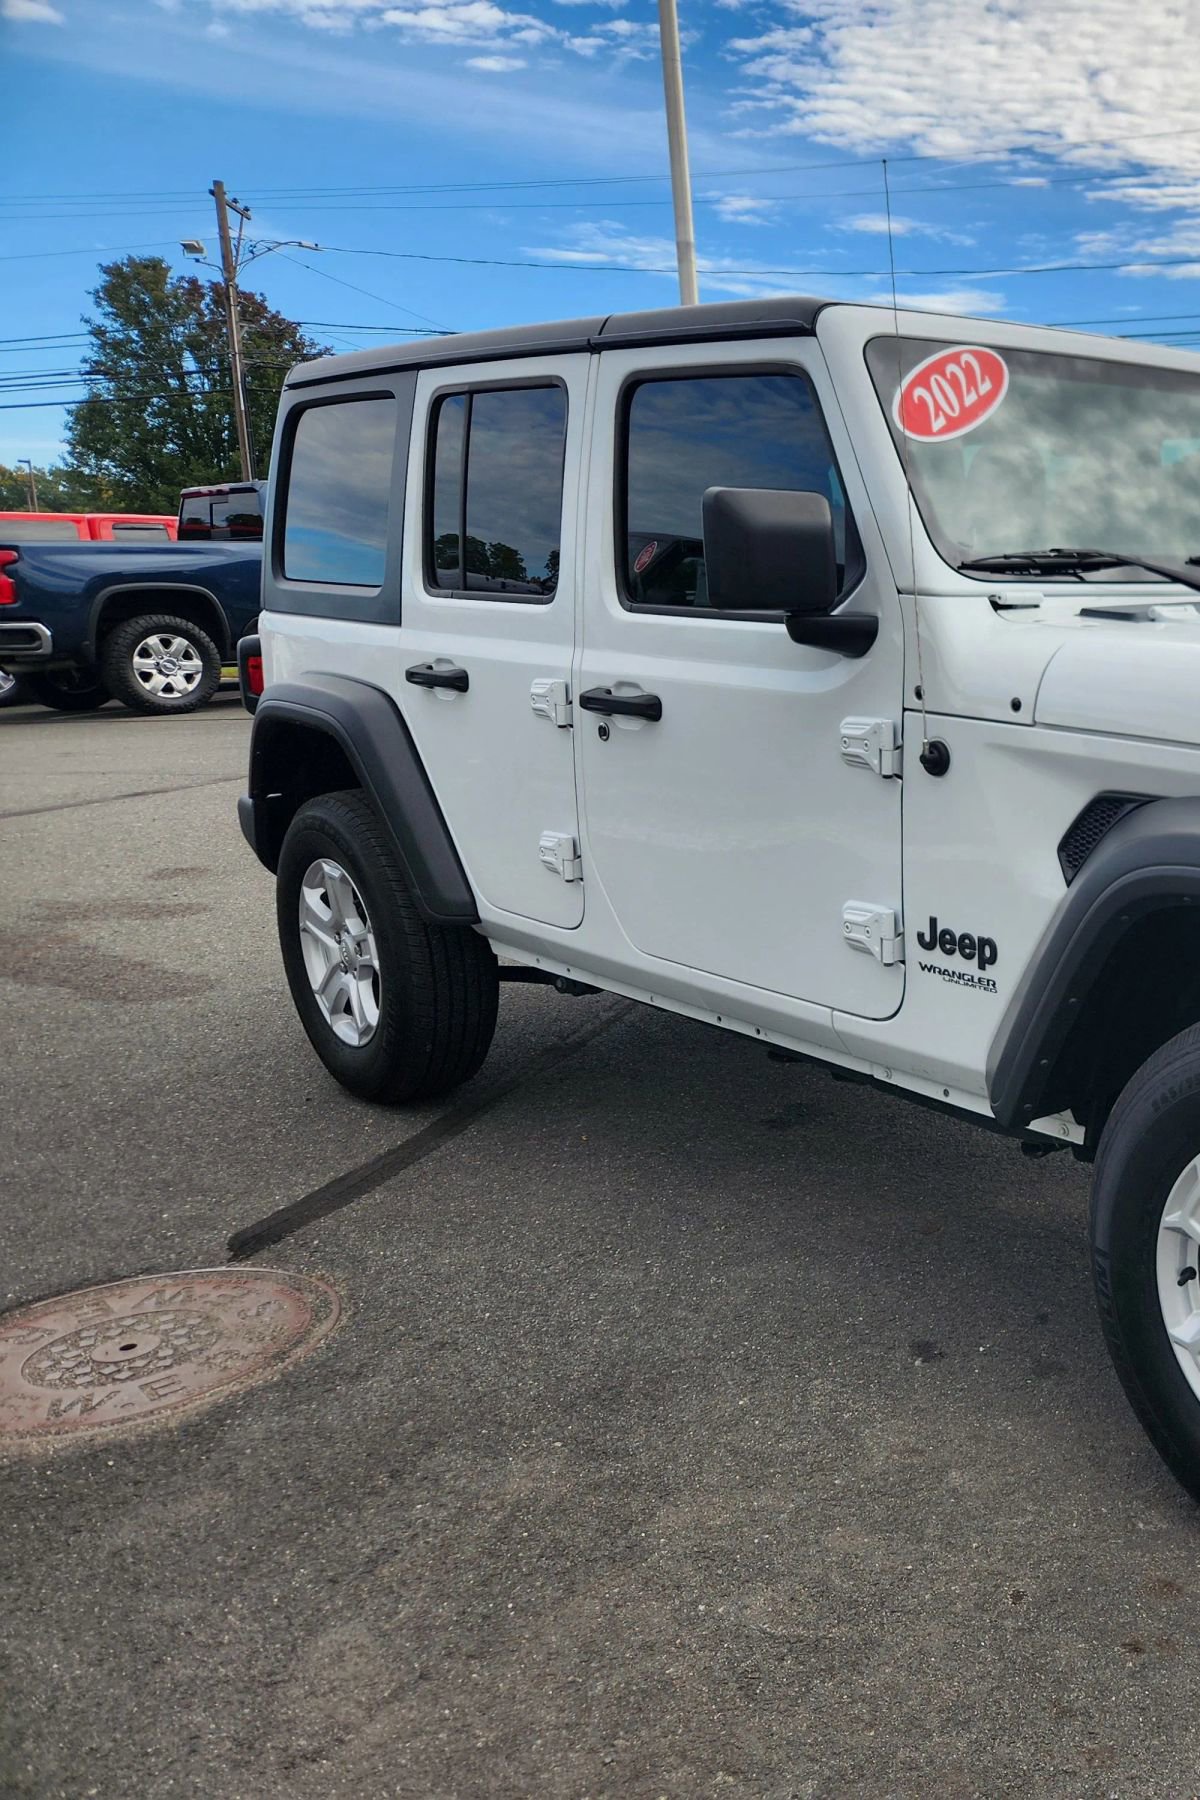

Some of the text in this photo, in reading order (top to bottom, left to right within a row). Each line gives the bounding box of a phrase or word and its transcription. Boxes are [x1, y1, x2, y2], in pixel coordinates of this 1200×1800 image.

[912, 352, 993, 433] 2022
[917, 915, 998, 971] Jeep
[918, 960, 997, 989] WRANGLER
[942, 976, 998, 993] UNLIMITED
